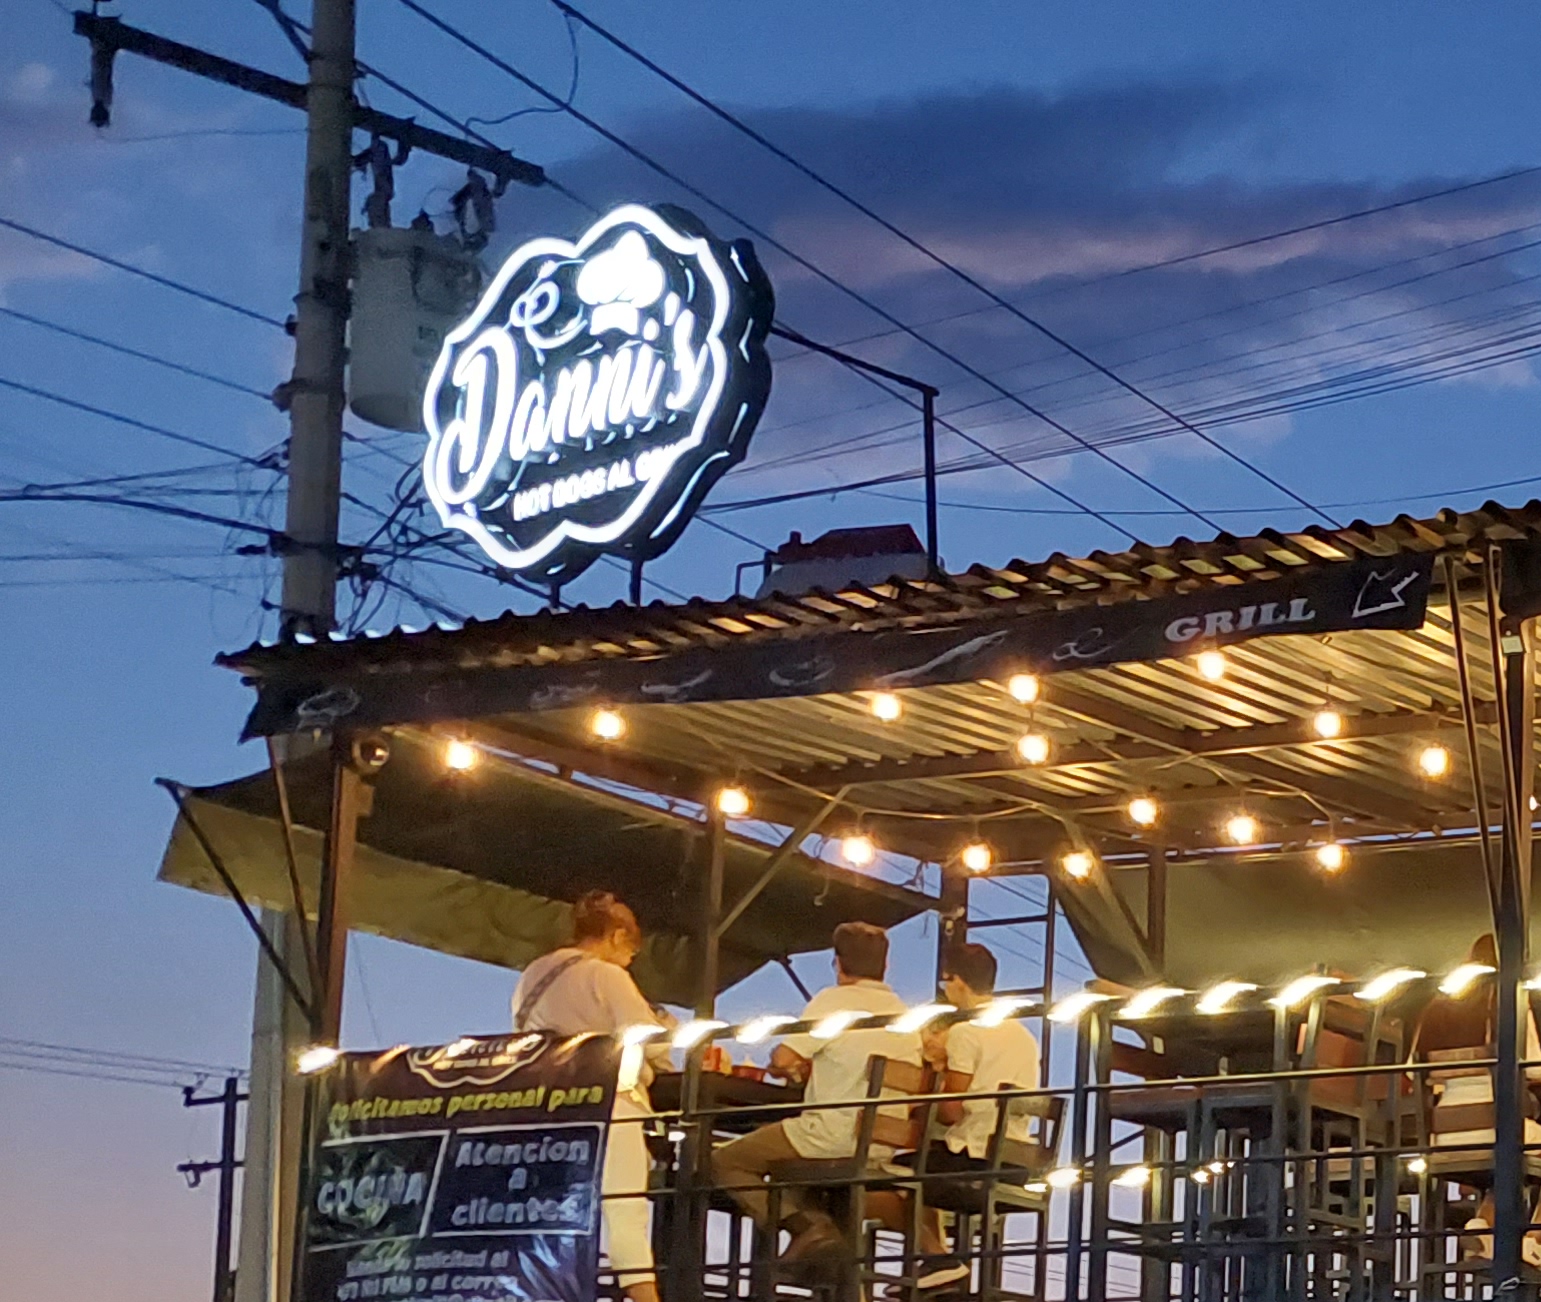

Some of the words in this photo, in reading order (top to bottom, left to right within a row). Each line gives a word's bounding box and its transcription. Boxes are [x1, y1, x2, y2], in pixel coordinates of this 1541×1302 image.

[435, 293, 702, 505] Danni's
[1164, 598, 1316, 643] GRILL
[446, 1086, 543, 1118] personal
[547, 1086, 604, 1112] para
